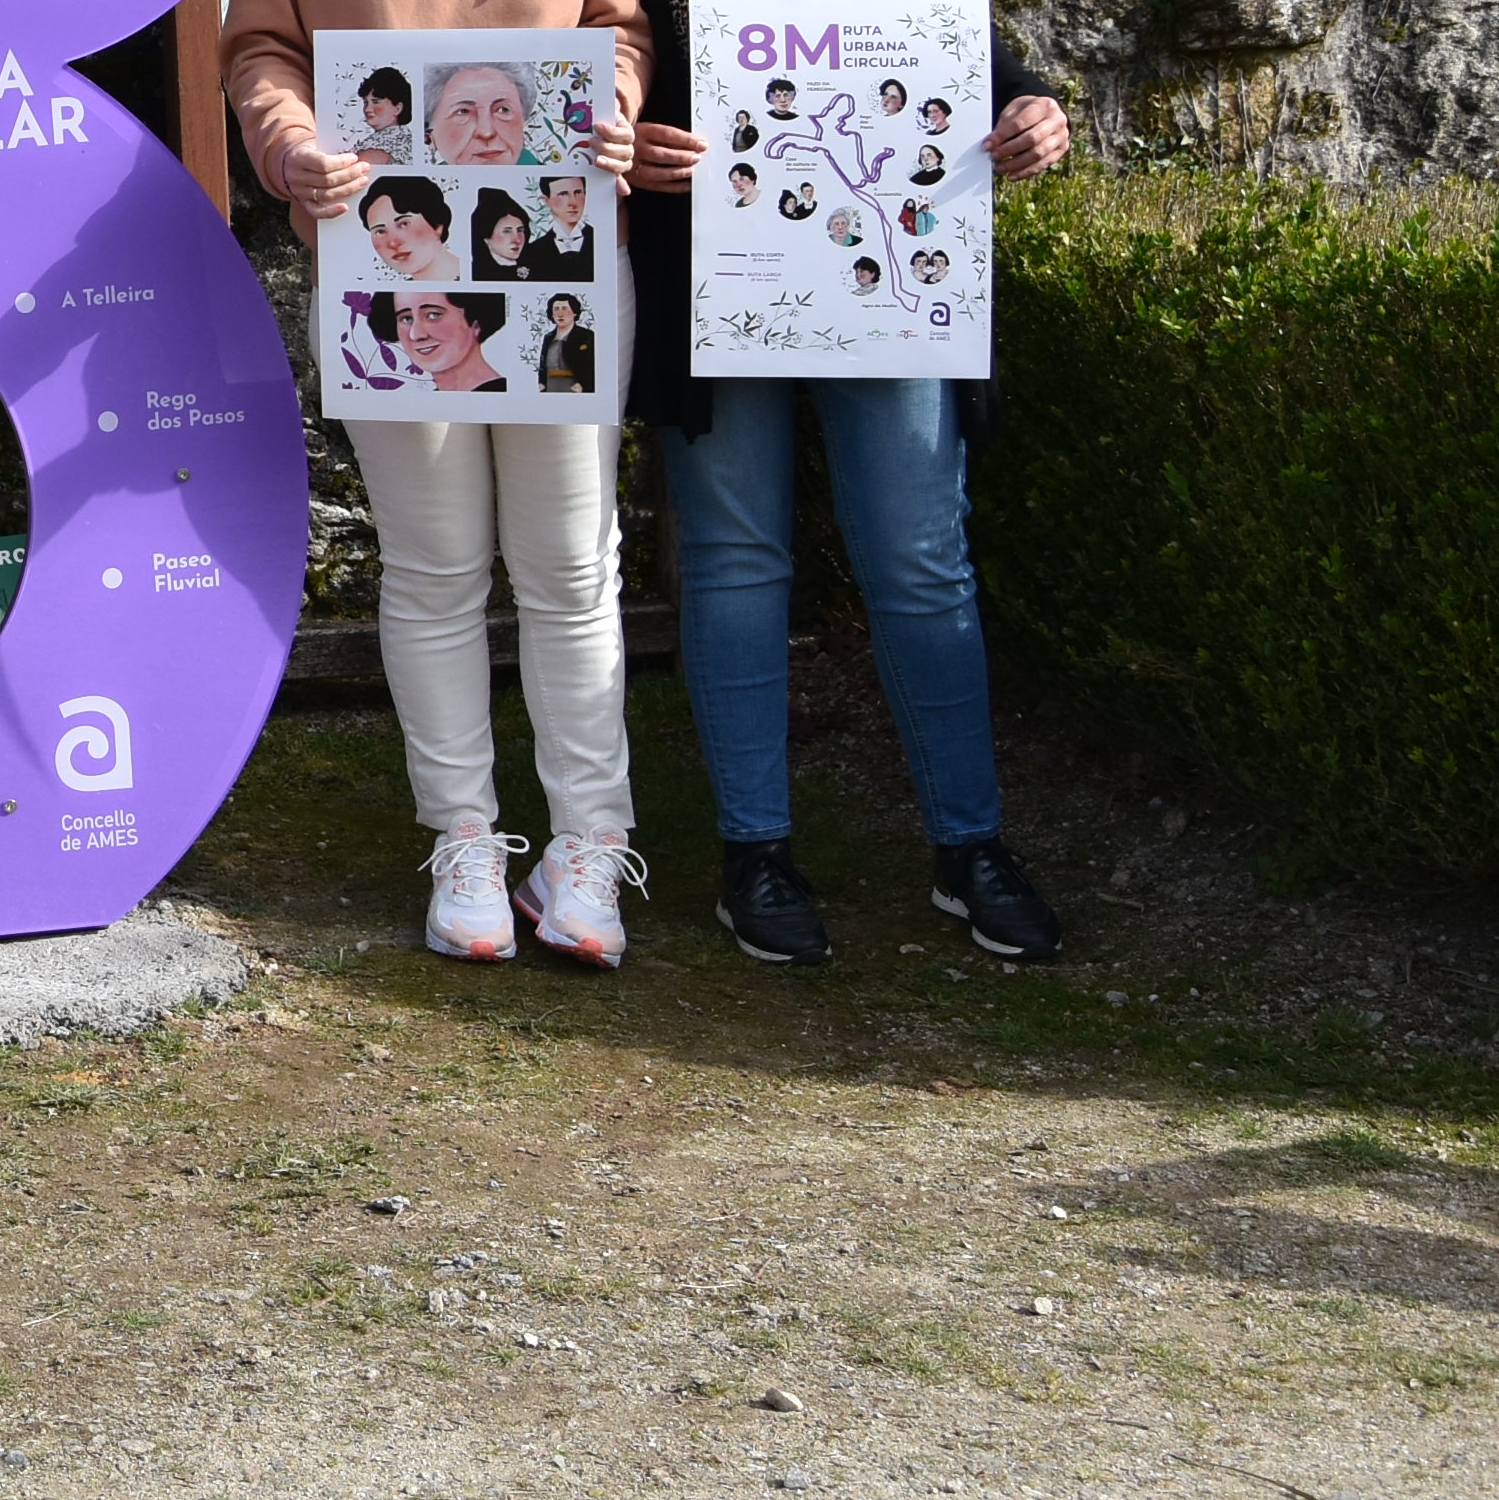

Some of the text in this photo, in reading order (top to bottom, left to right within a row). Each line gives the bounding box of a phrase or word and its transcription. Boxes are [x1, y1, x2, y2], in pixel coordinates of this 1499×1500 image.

[843, 26, 882, 35] RUTA
[737, 23, 840, 71] 8M
[843, 41, 907, 51] URBANA
[843, 57, 919, 68] CIRCULAR
[62, 285, 154, 308] A Telleira
[147, 391, 196, 414] Rego
[148, 409, 244, 430] dos Pasos
[153, 553, 211, 572] Paseo
[155, 569, 219, 592] Fluvial
[62, 810, 135, 831] Concello
[61, 829, 138, 851] de AMES
